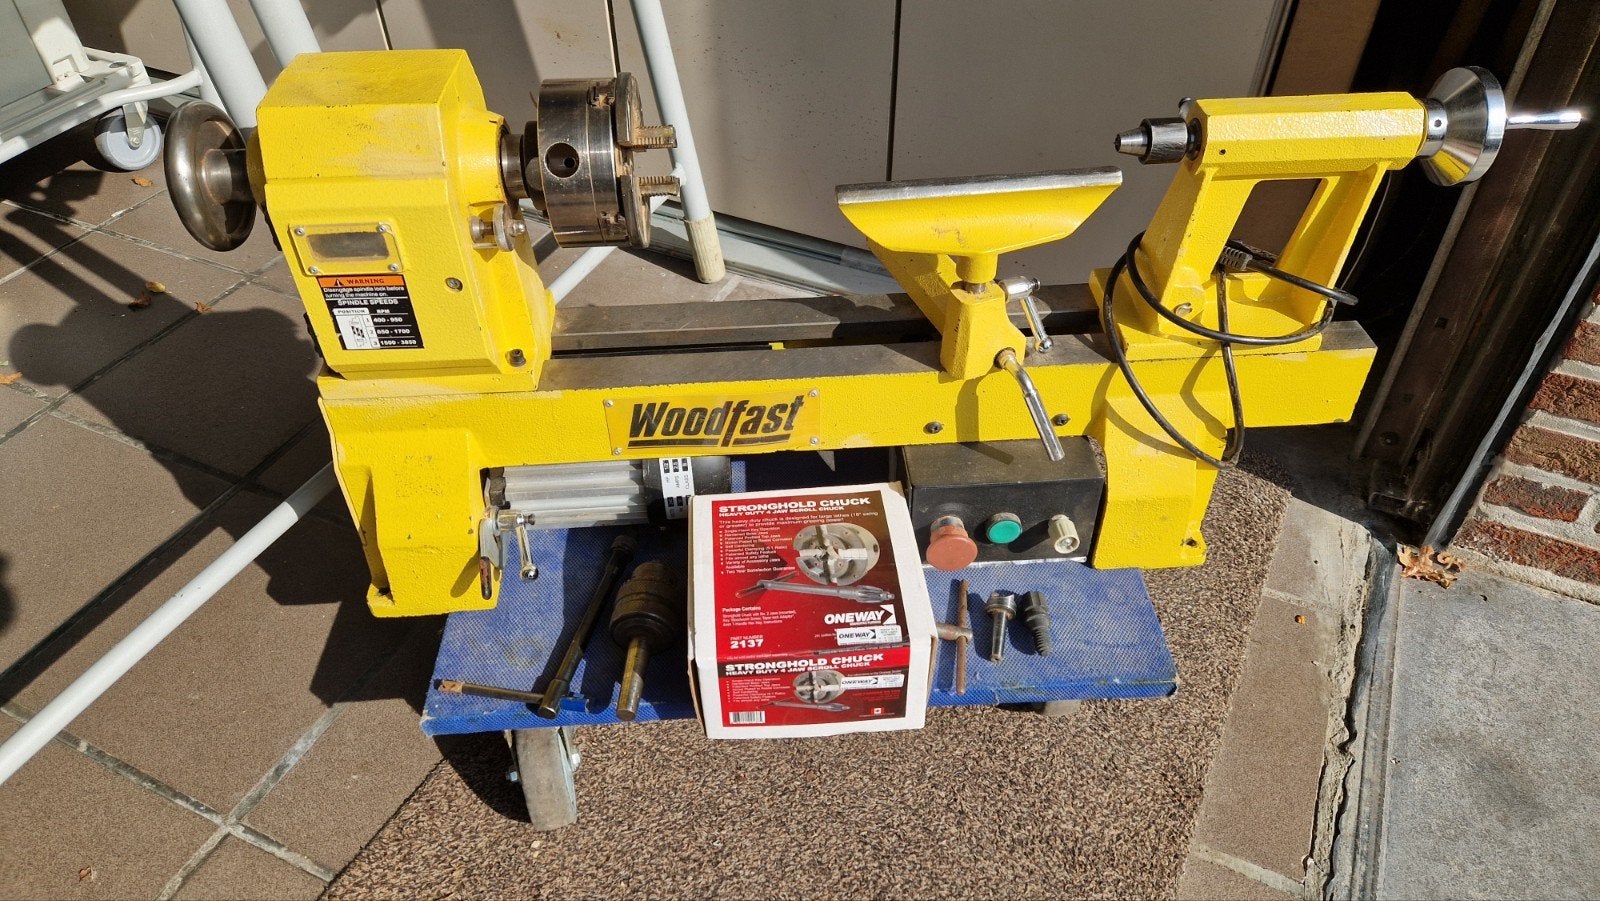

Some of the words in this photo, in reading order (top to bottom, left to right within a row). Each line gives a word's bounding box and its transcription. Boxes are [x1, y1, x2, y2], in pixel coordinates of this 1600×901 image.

[629, 395, 804, 448] Woodfast
[719, 501, 816, 512] STRONGHOLD
[820, 498, 870, 507] CHUCK
[824, 610, 885, 624] ONEWAY
[730, 640, 764, 649] 2137
[725, 658, 827, 672] STRONGHOLD
[832, 654, 884, 664] CHUCK
